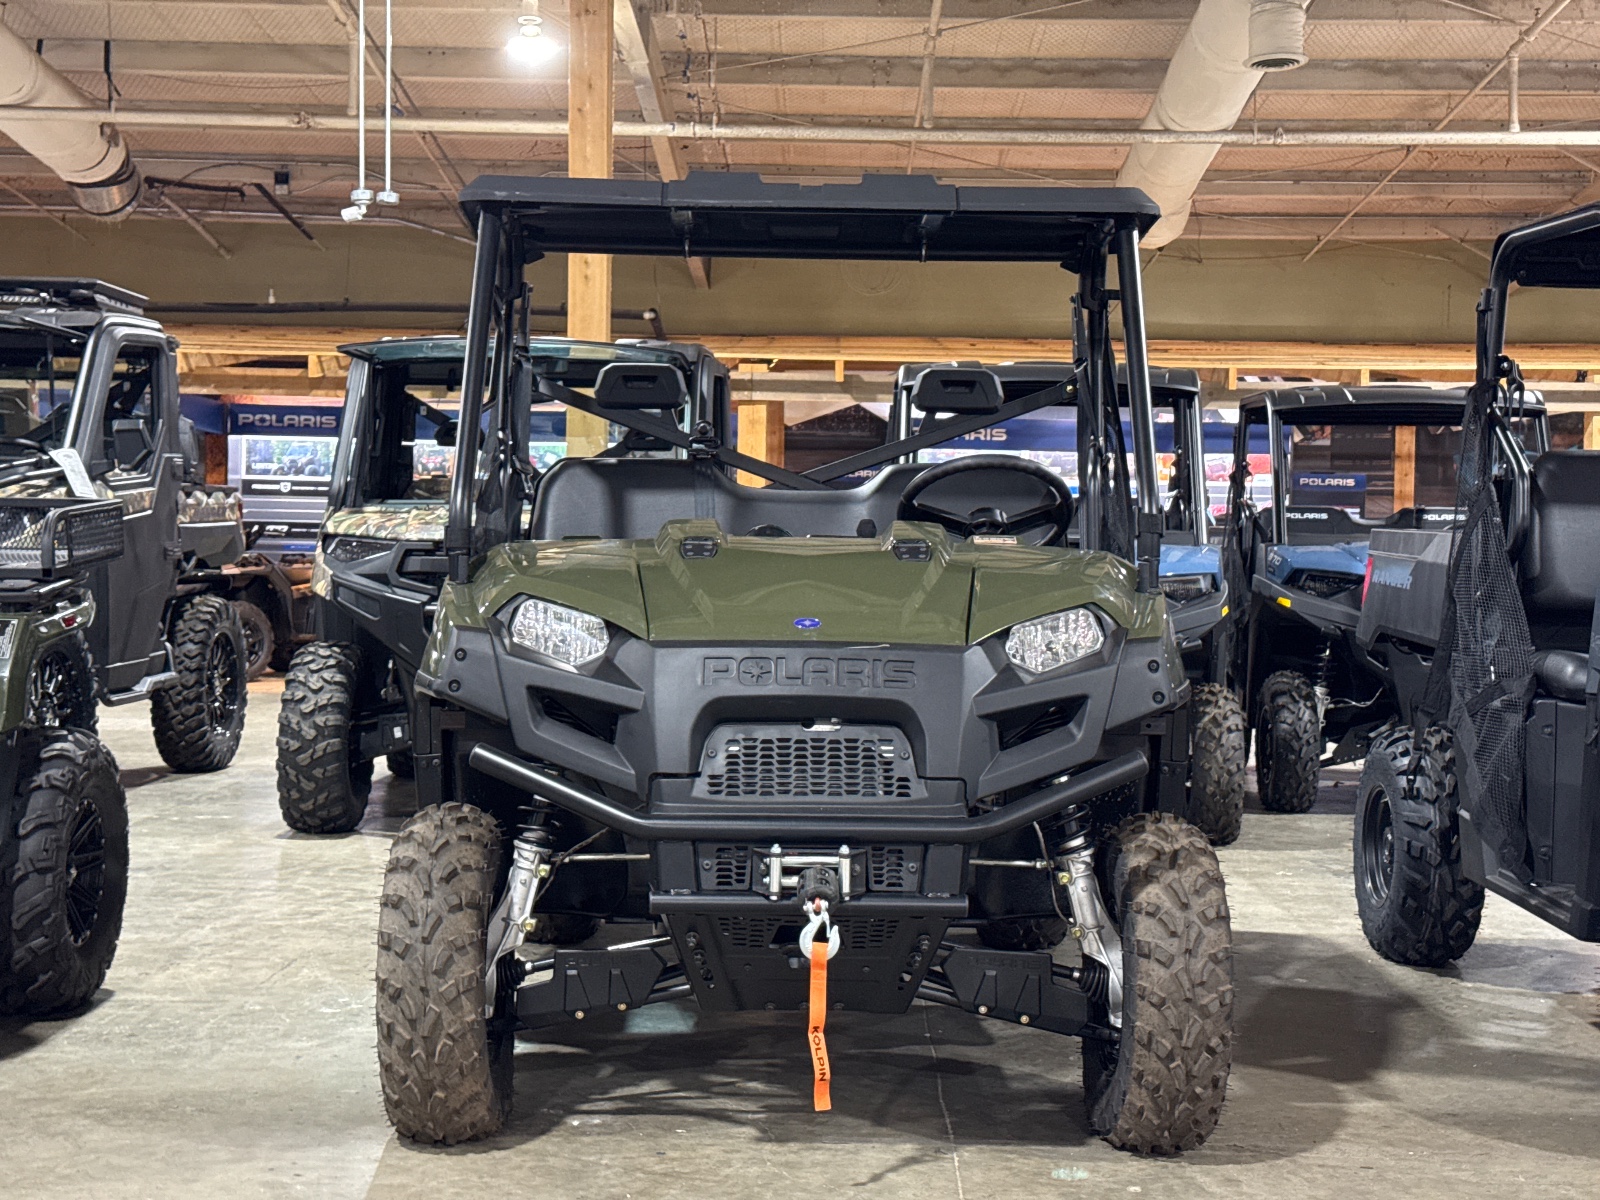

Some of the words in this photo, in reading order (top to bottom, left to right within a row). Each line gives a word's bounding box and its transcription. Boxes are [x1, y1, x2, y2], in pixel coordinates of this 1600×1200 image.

[238, 413, 337, 428] POLARIS
[1299, 477, 1356, 487] POLARIS
[1285, 512, 1329, 520] POLARIS
[702, 656, 917, 689] POLARIS
[811, 1025, 828, 1082] KOLPIN
